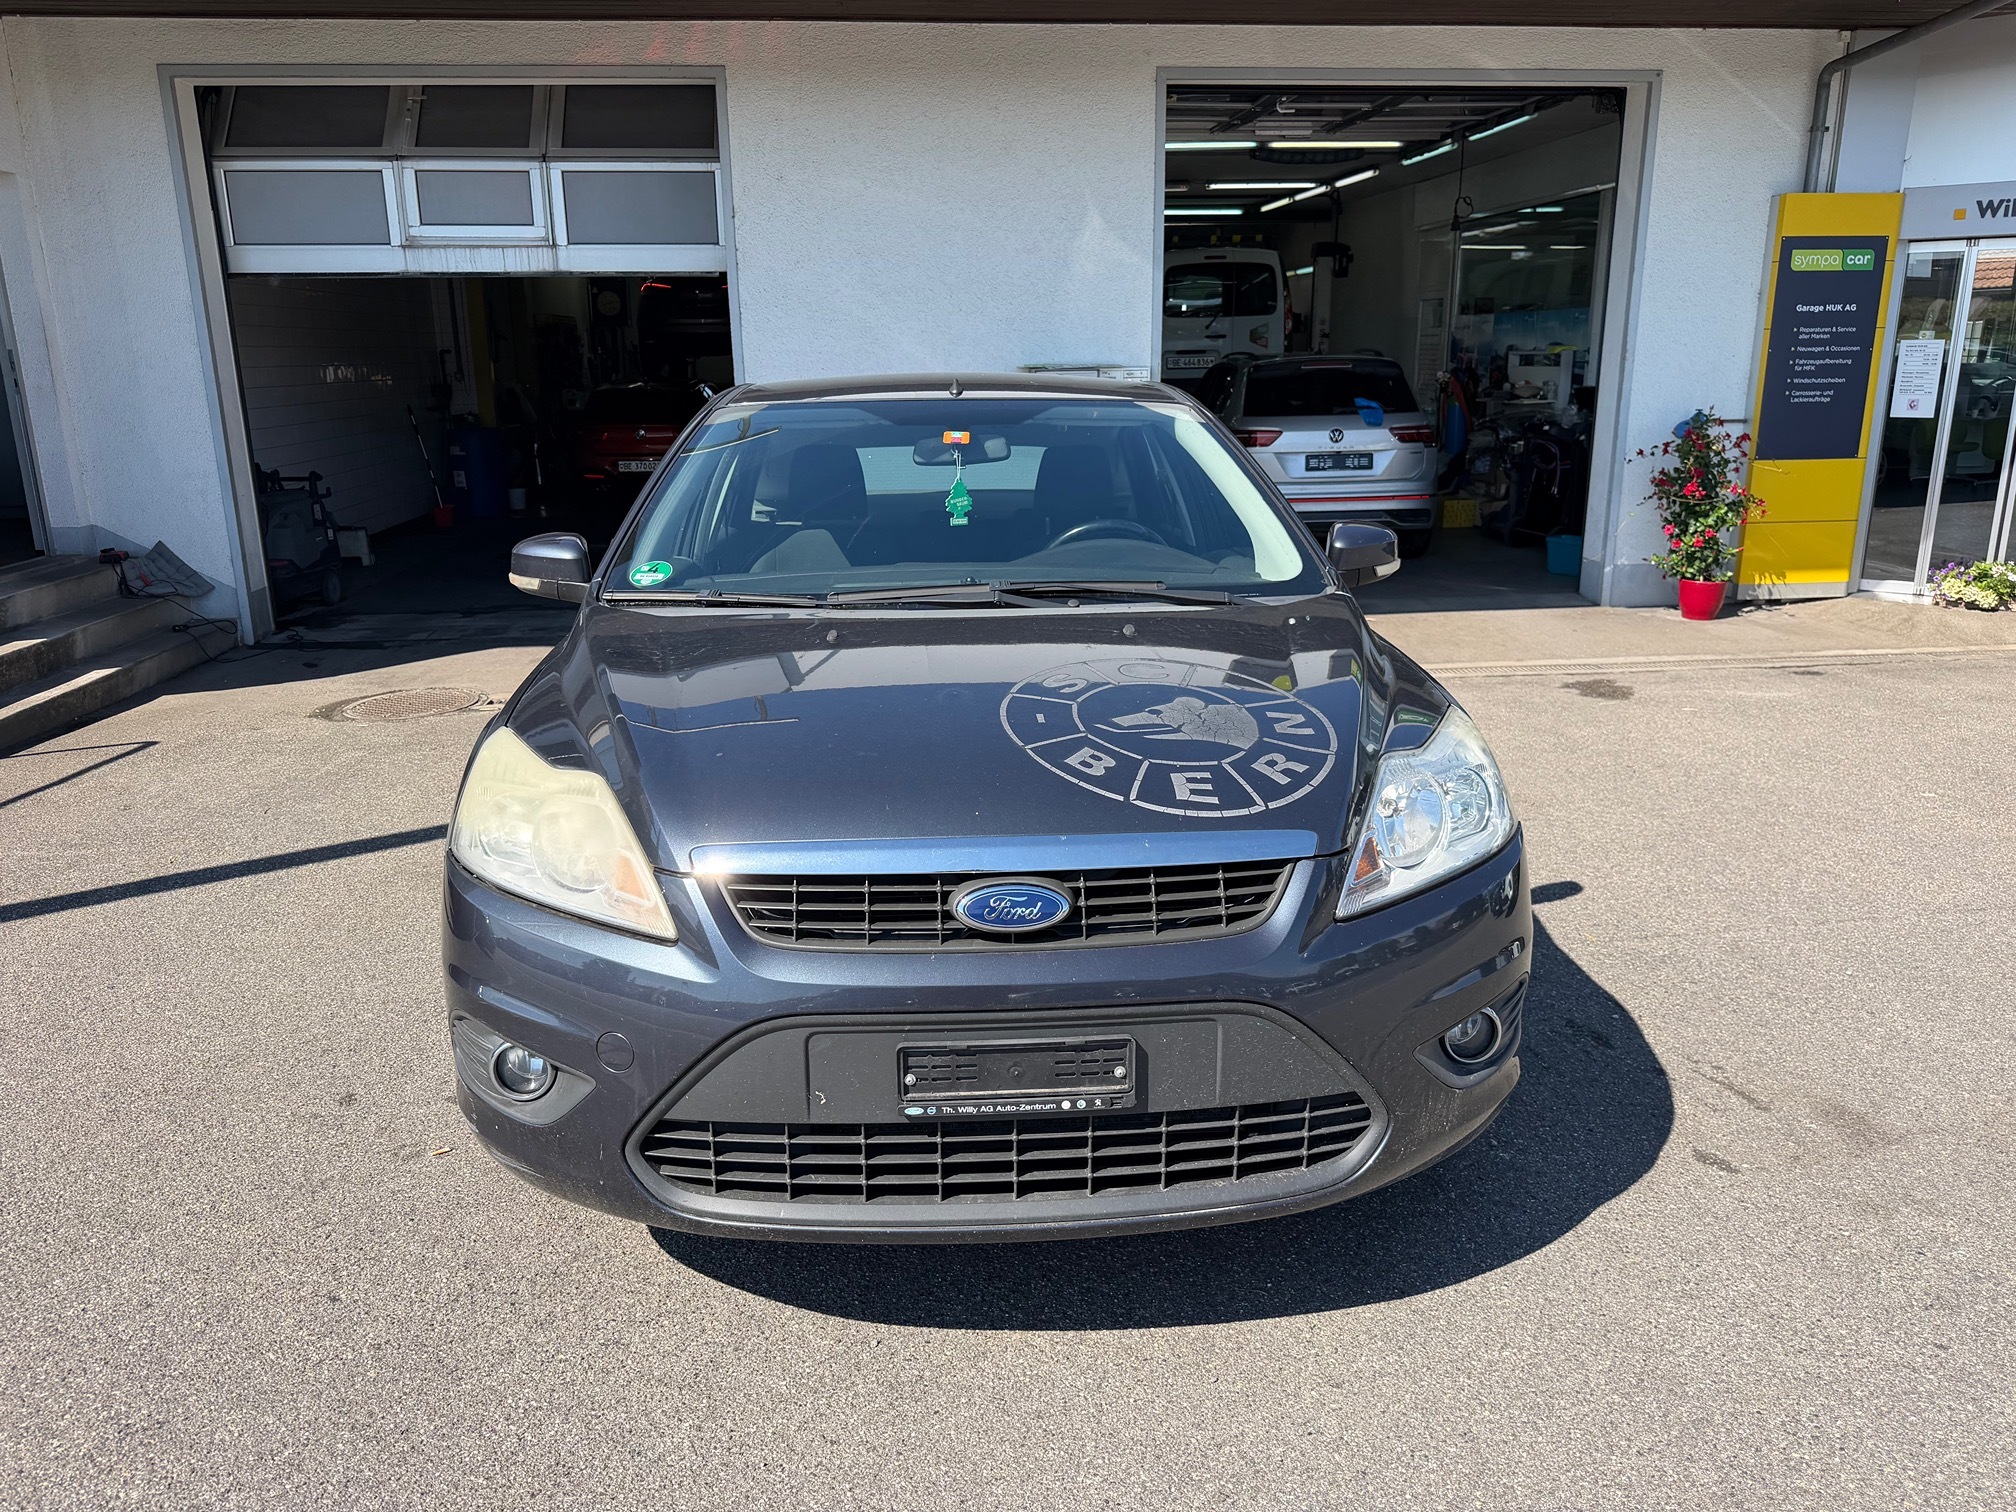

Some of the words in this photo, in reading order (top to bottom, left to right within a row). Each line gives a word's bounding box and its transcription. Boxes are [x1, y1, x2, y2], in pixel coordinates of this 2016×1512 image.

[1794, 252, 1839, 268] sympa
[1846, 252, 1871, 265] car
[1796, 304, 1824, 313] Garage
[984, 895, 1042, 921] Ford
[942, 1106, 955, 1114] Th.
[958, 1105, 978, 1115] Willy
[995, 1102, 1057, 1112] Auto-Zentrum
